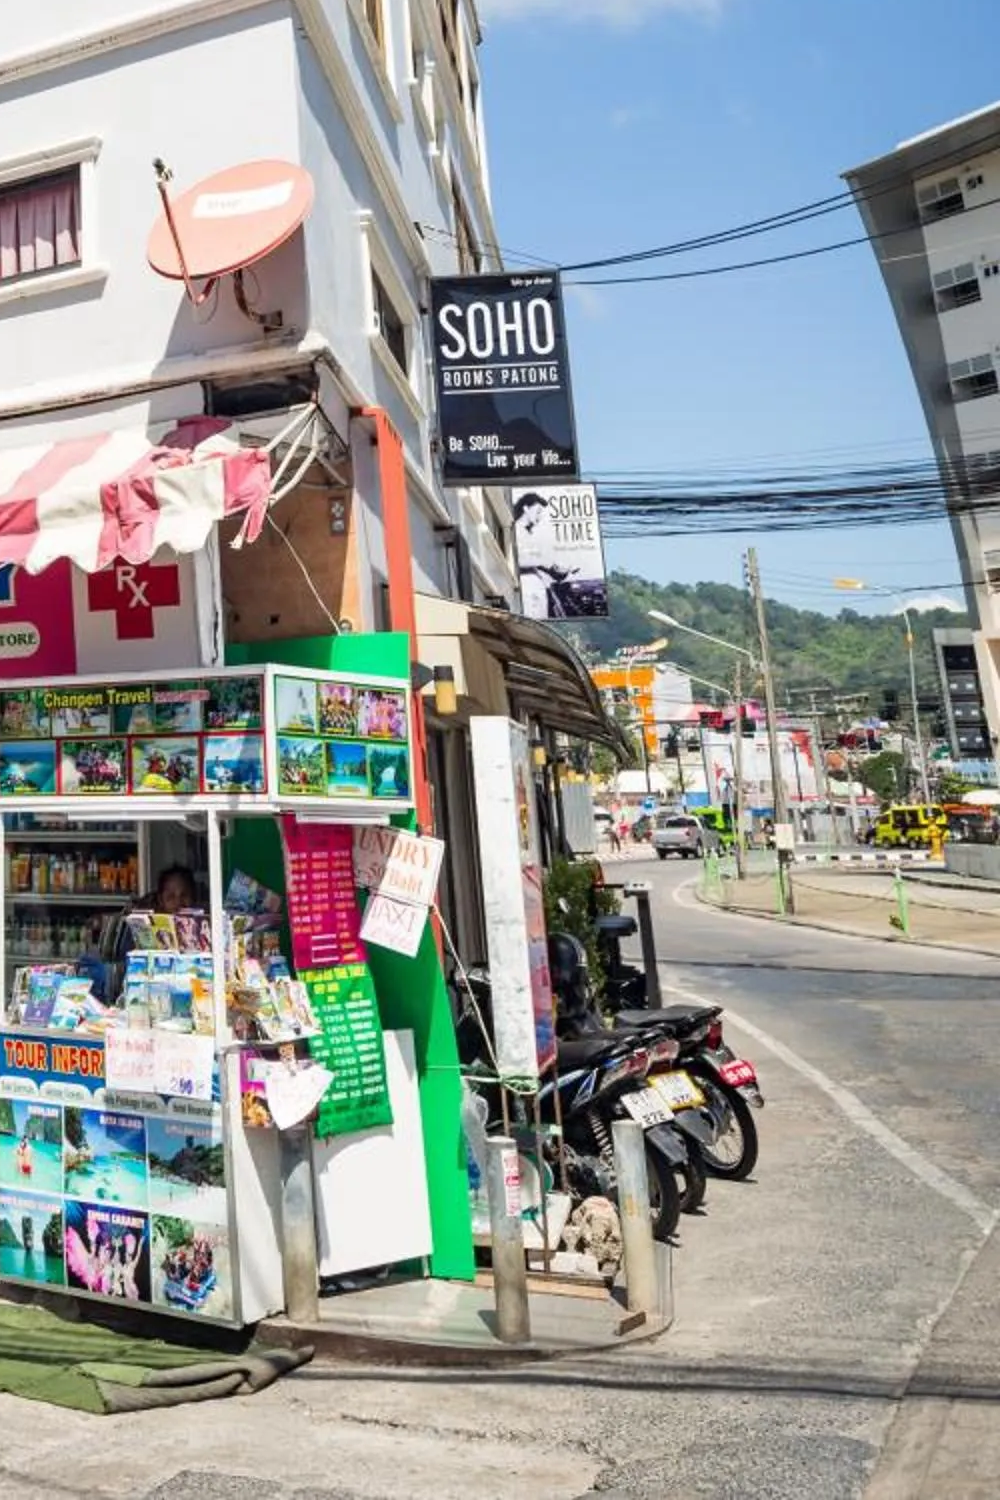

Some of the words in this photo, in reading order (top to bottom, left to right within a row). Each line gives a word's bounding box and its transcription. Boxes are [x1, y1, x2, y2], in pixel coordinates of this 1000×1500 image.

[439, 298, 556, 360] SOHO
[443, 368, 494, 388] ROOMS
[502, 365, 559, 385] PATONG
[449, 436, 463, 452] Be
[549, 495, 594, 519] SOHO
[552, 522, 595, 542] TIME
[107, 687, 151, 706] Travel
[4, 1040, 48, 1071] TOUR
